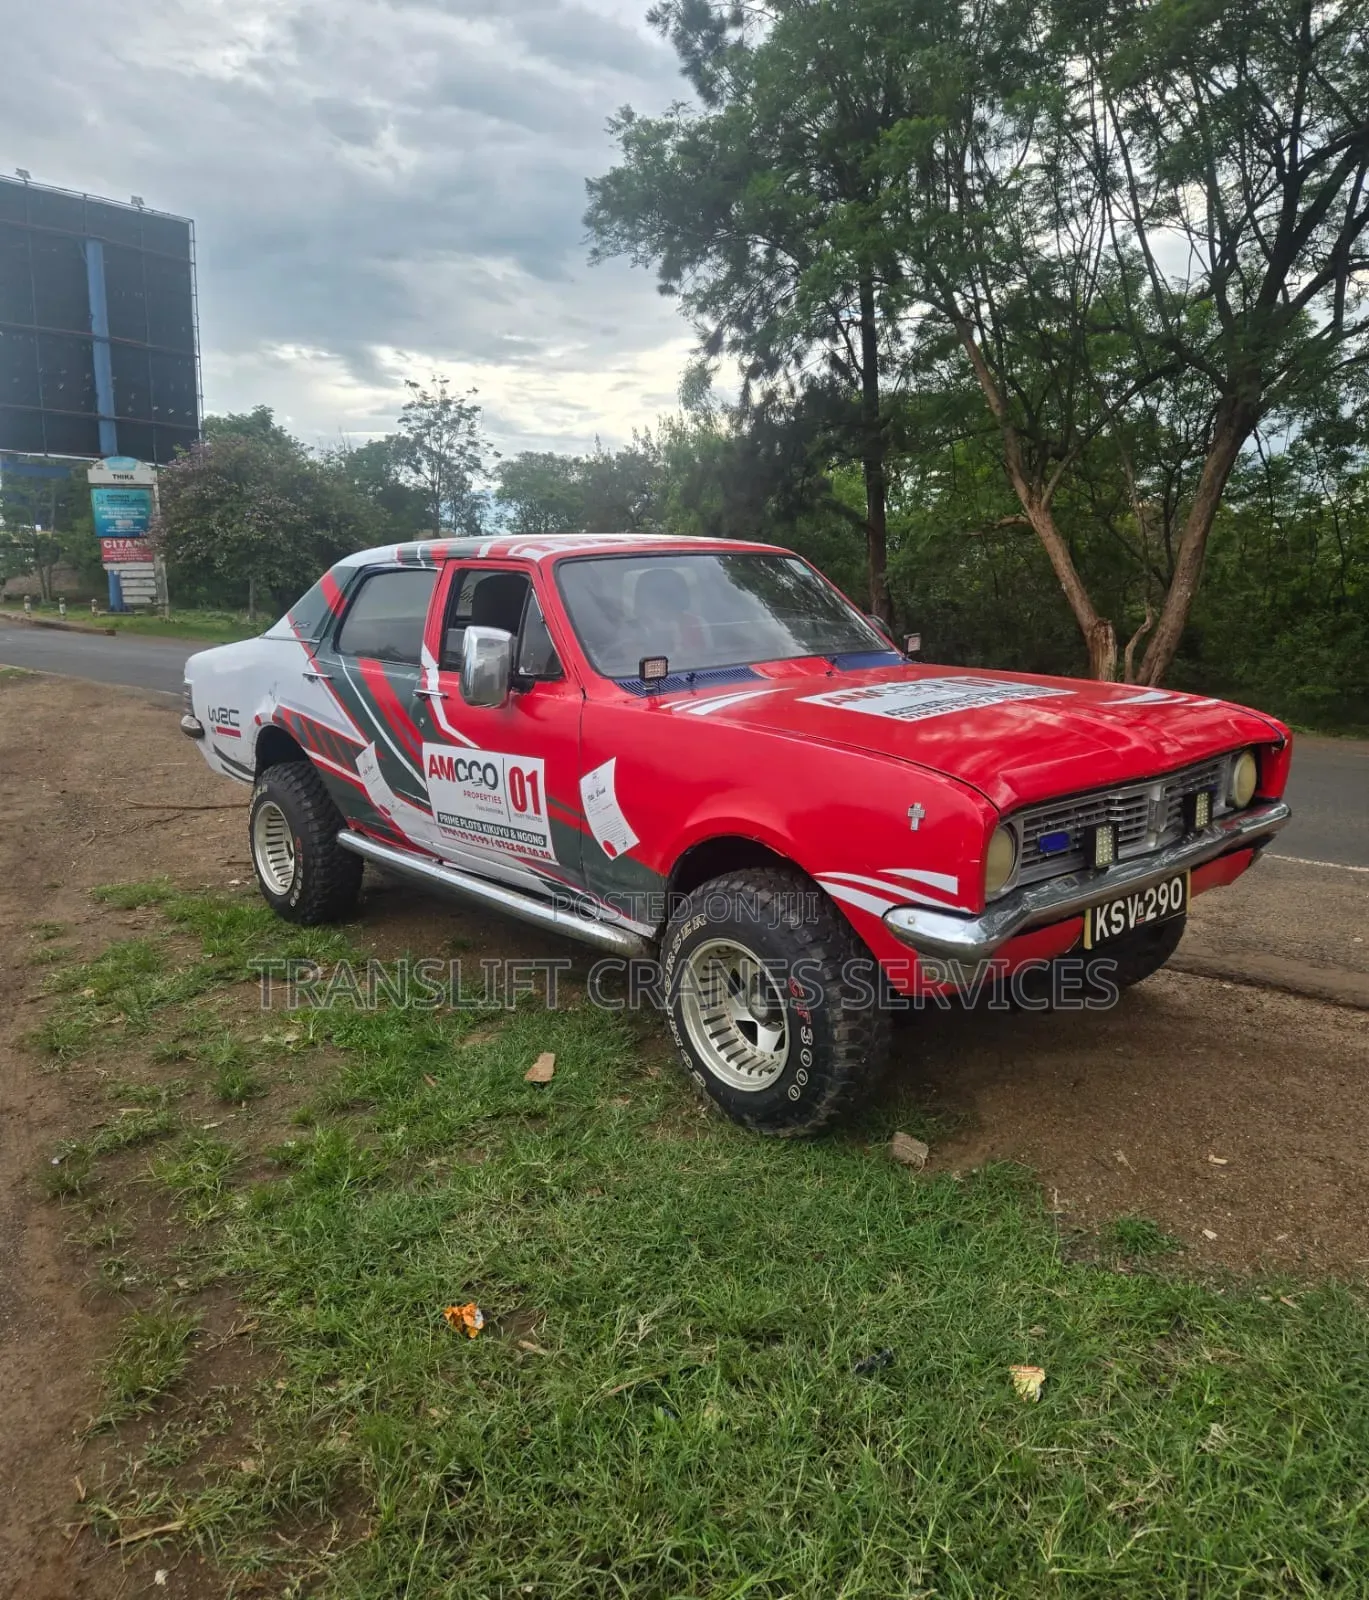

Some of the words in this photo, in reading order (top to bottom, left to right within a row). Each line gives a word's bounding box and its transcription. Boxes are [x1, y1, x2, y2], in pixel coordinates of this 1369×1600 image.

[112, 473, 135, 481] THIKA
[428, 754, 499, 790] AMCCO
[463, 789, 502, 805] PROPERTIES
[509, 766, 542, 816] 01
[440, 813, 460, 827] PRIME
[460, 818, 482, 832] PLOTS
[482, 823, 510, 839] KIKUYU
[510, 830, 517, 840] &
[517, 832, 545, 847] NGONG
[1096, 894, 1139, 941] KSV
[1144, 877, 1183, 922] 290
